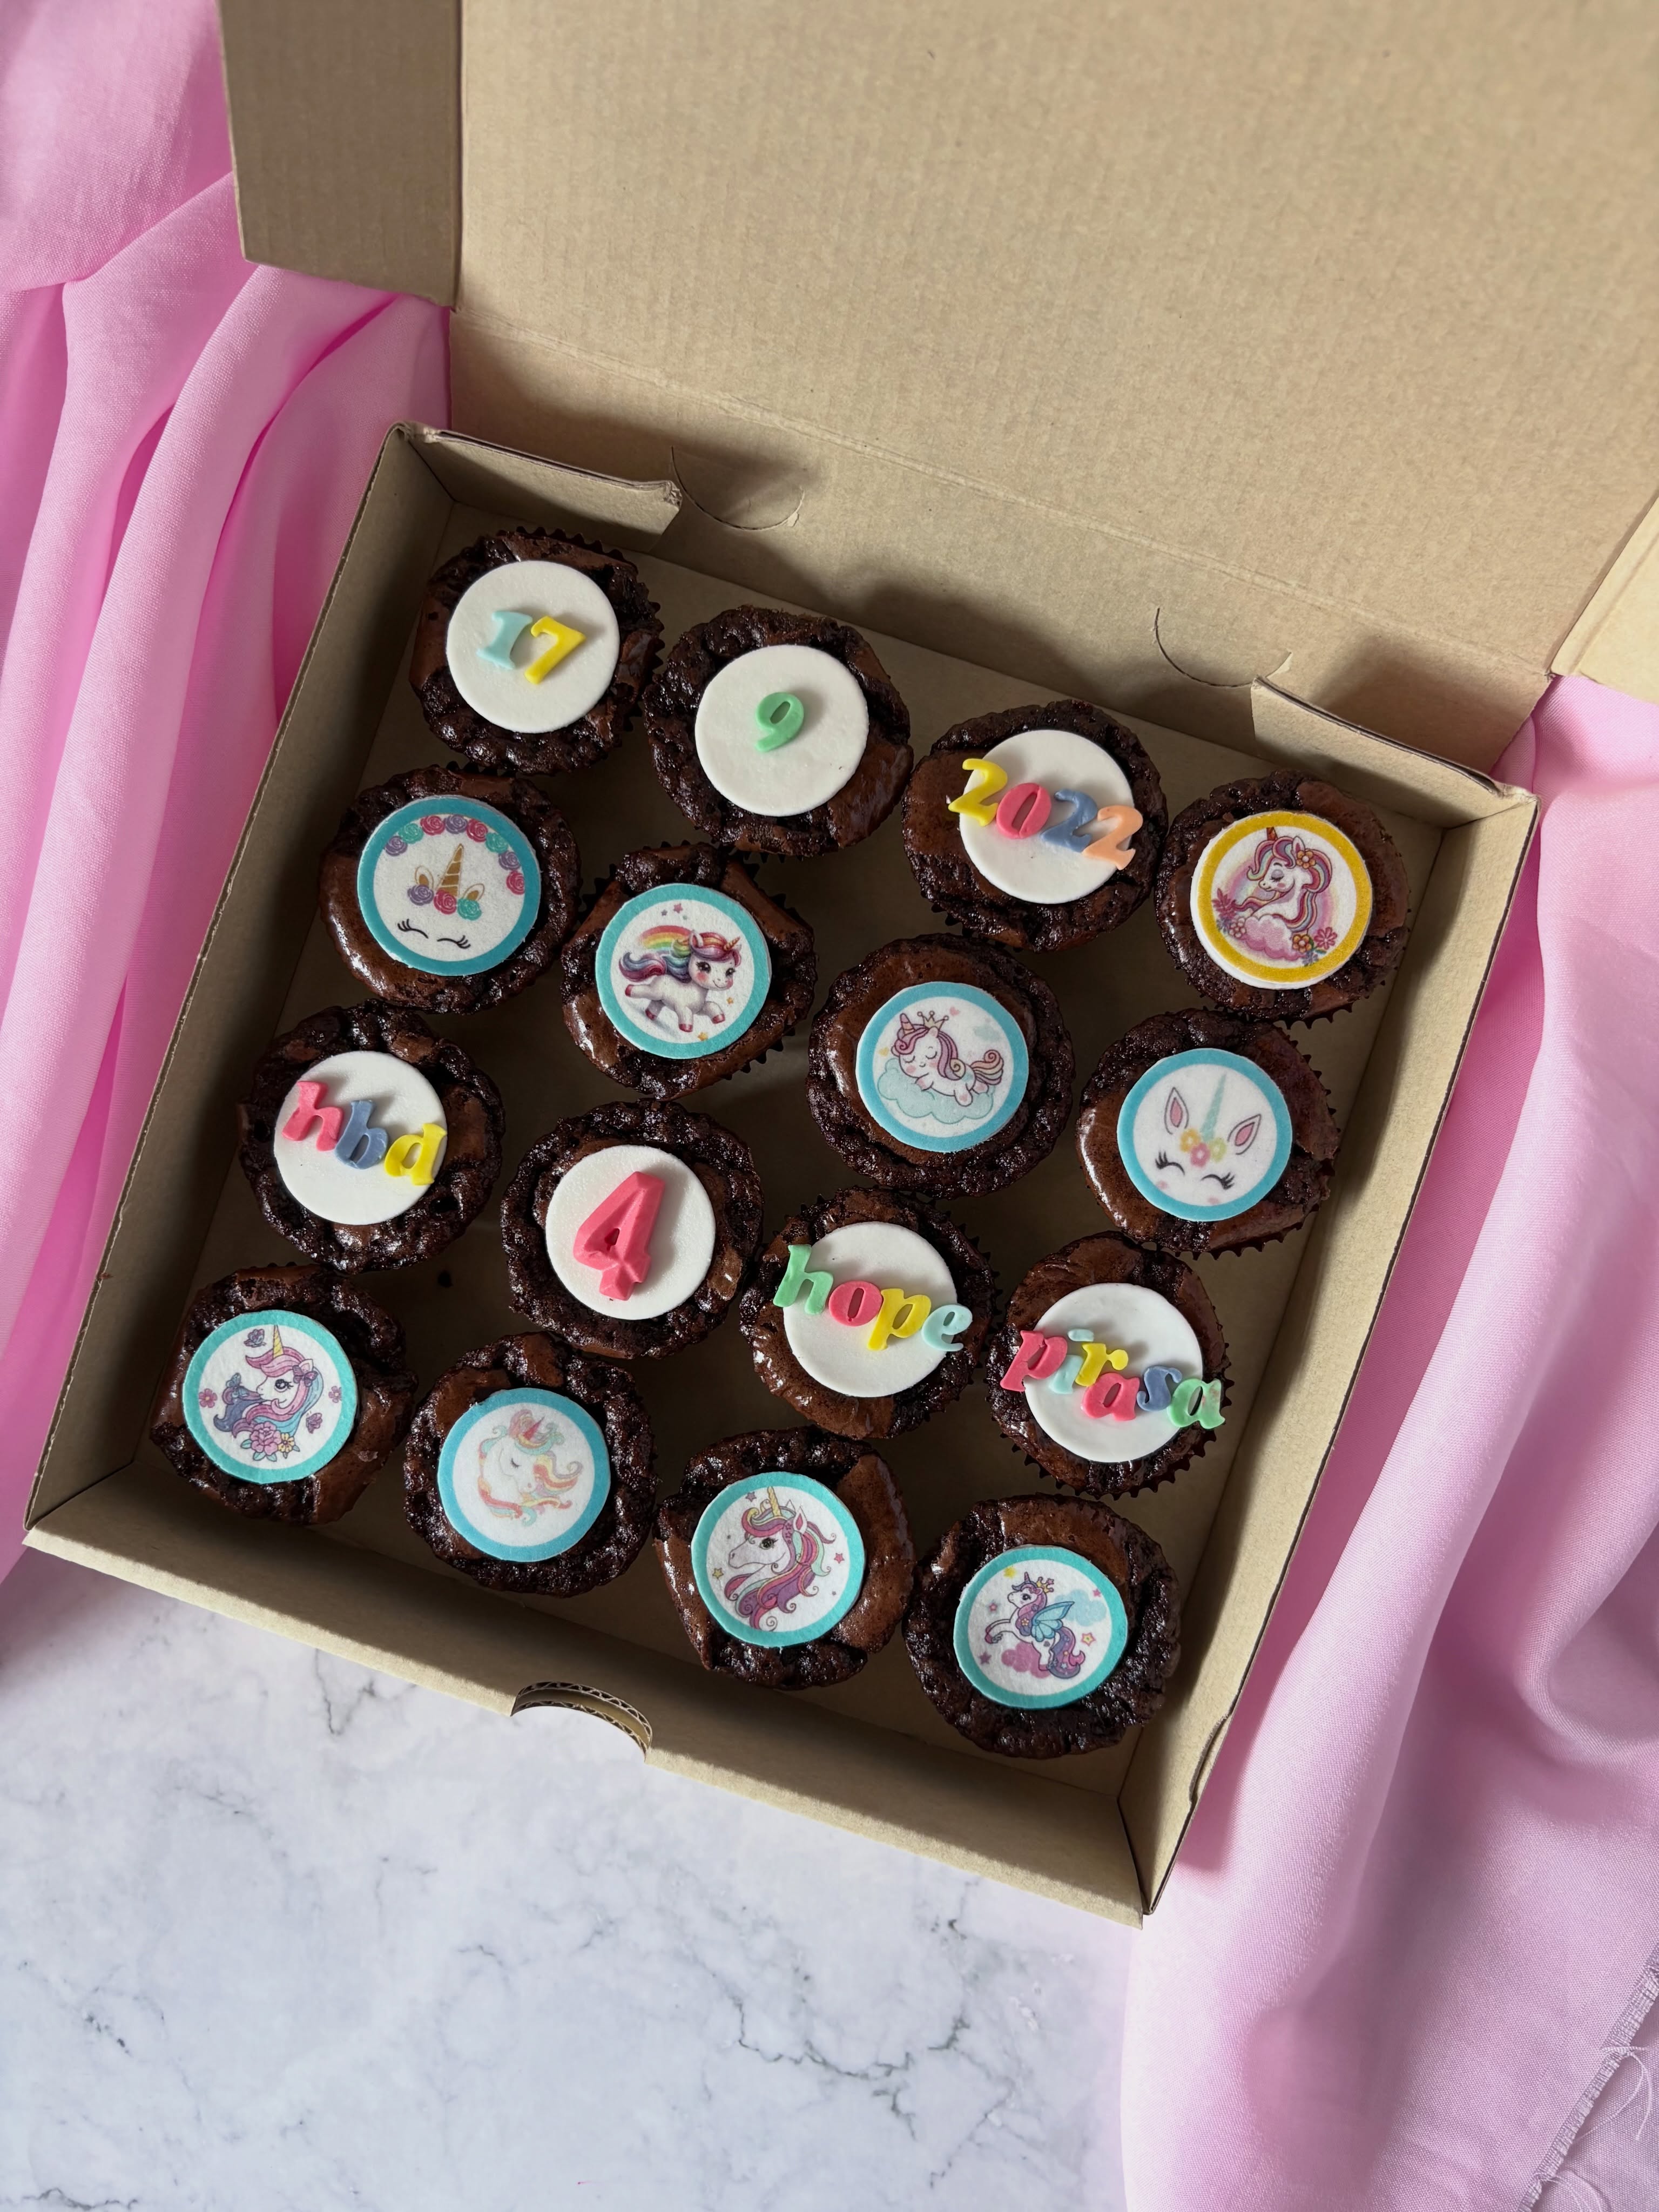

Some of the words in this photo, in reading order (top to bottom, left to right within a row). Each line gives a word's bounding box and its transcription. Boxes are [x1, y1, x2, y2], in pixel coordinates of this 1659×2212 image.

[476, 611, 586, 685] 17
[756, 692, 804, 752] 9
[948, 758, 1143, 870] 2022
[282, 1081, 447, 1185] hbd
[573, 1171, 665, 1301] 4
[773, 1244, 972, 1352] hope
[1000, 1329, 1225, 1429] pirasa
